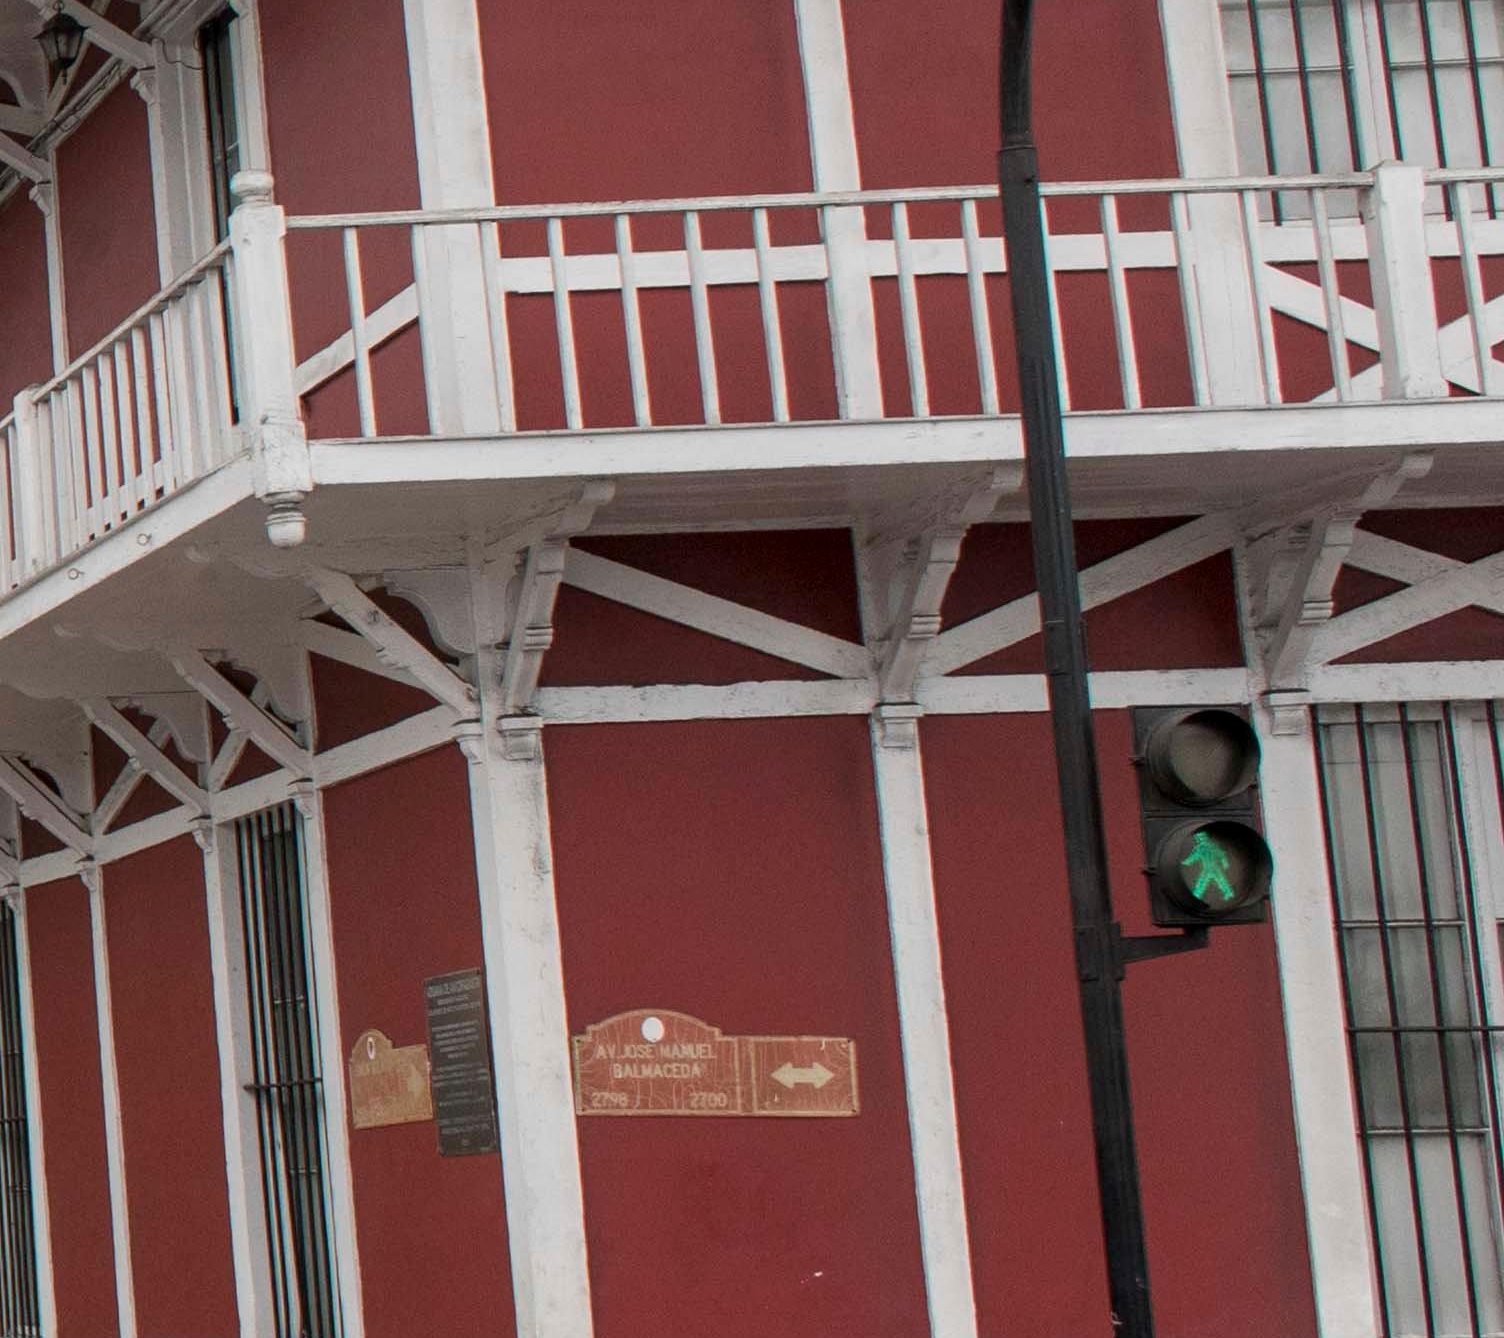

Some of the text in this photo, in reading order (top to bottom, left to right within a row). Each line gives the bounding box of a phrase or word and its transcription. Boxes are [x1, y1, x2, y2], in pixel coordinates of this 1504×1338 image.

[659, 1044, 717, 1059] MANUEL
[612, 1063, 702, 1078] BALMACEDA
[591, 1092, 629, 1107] 2798
